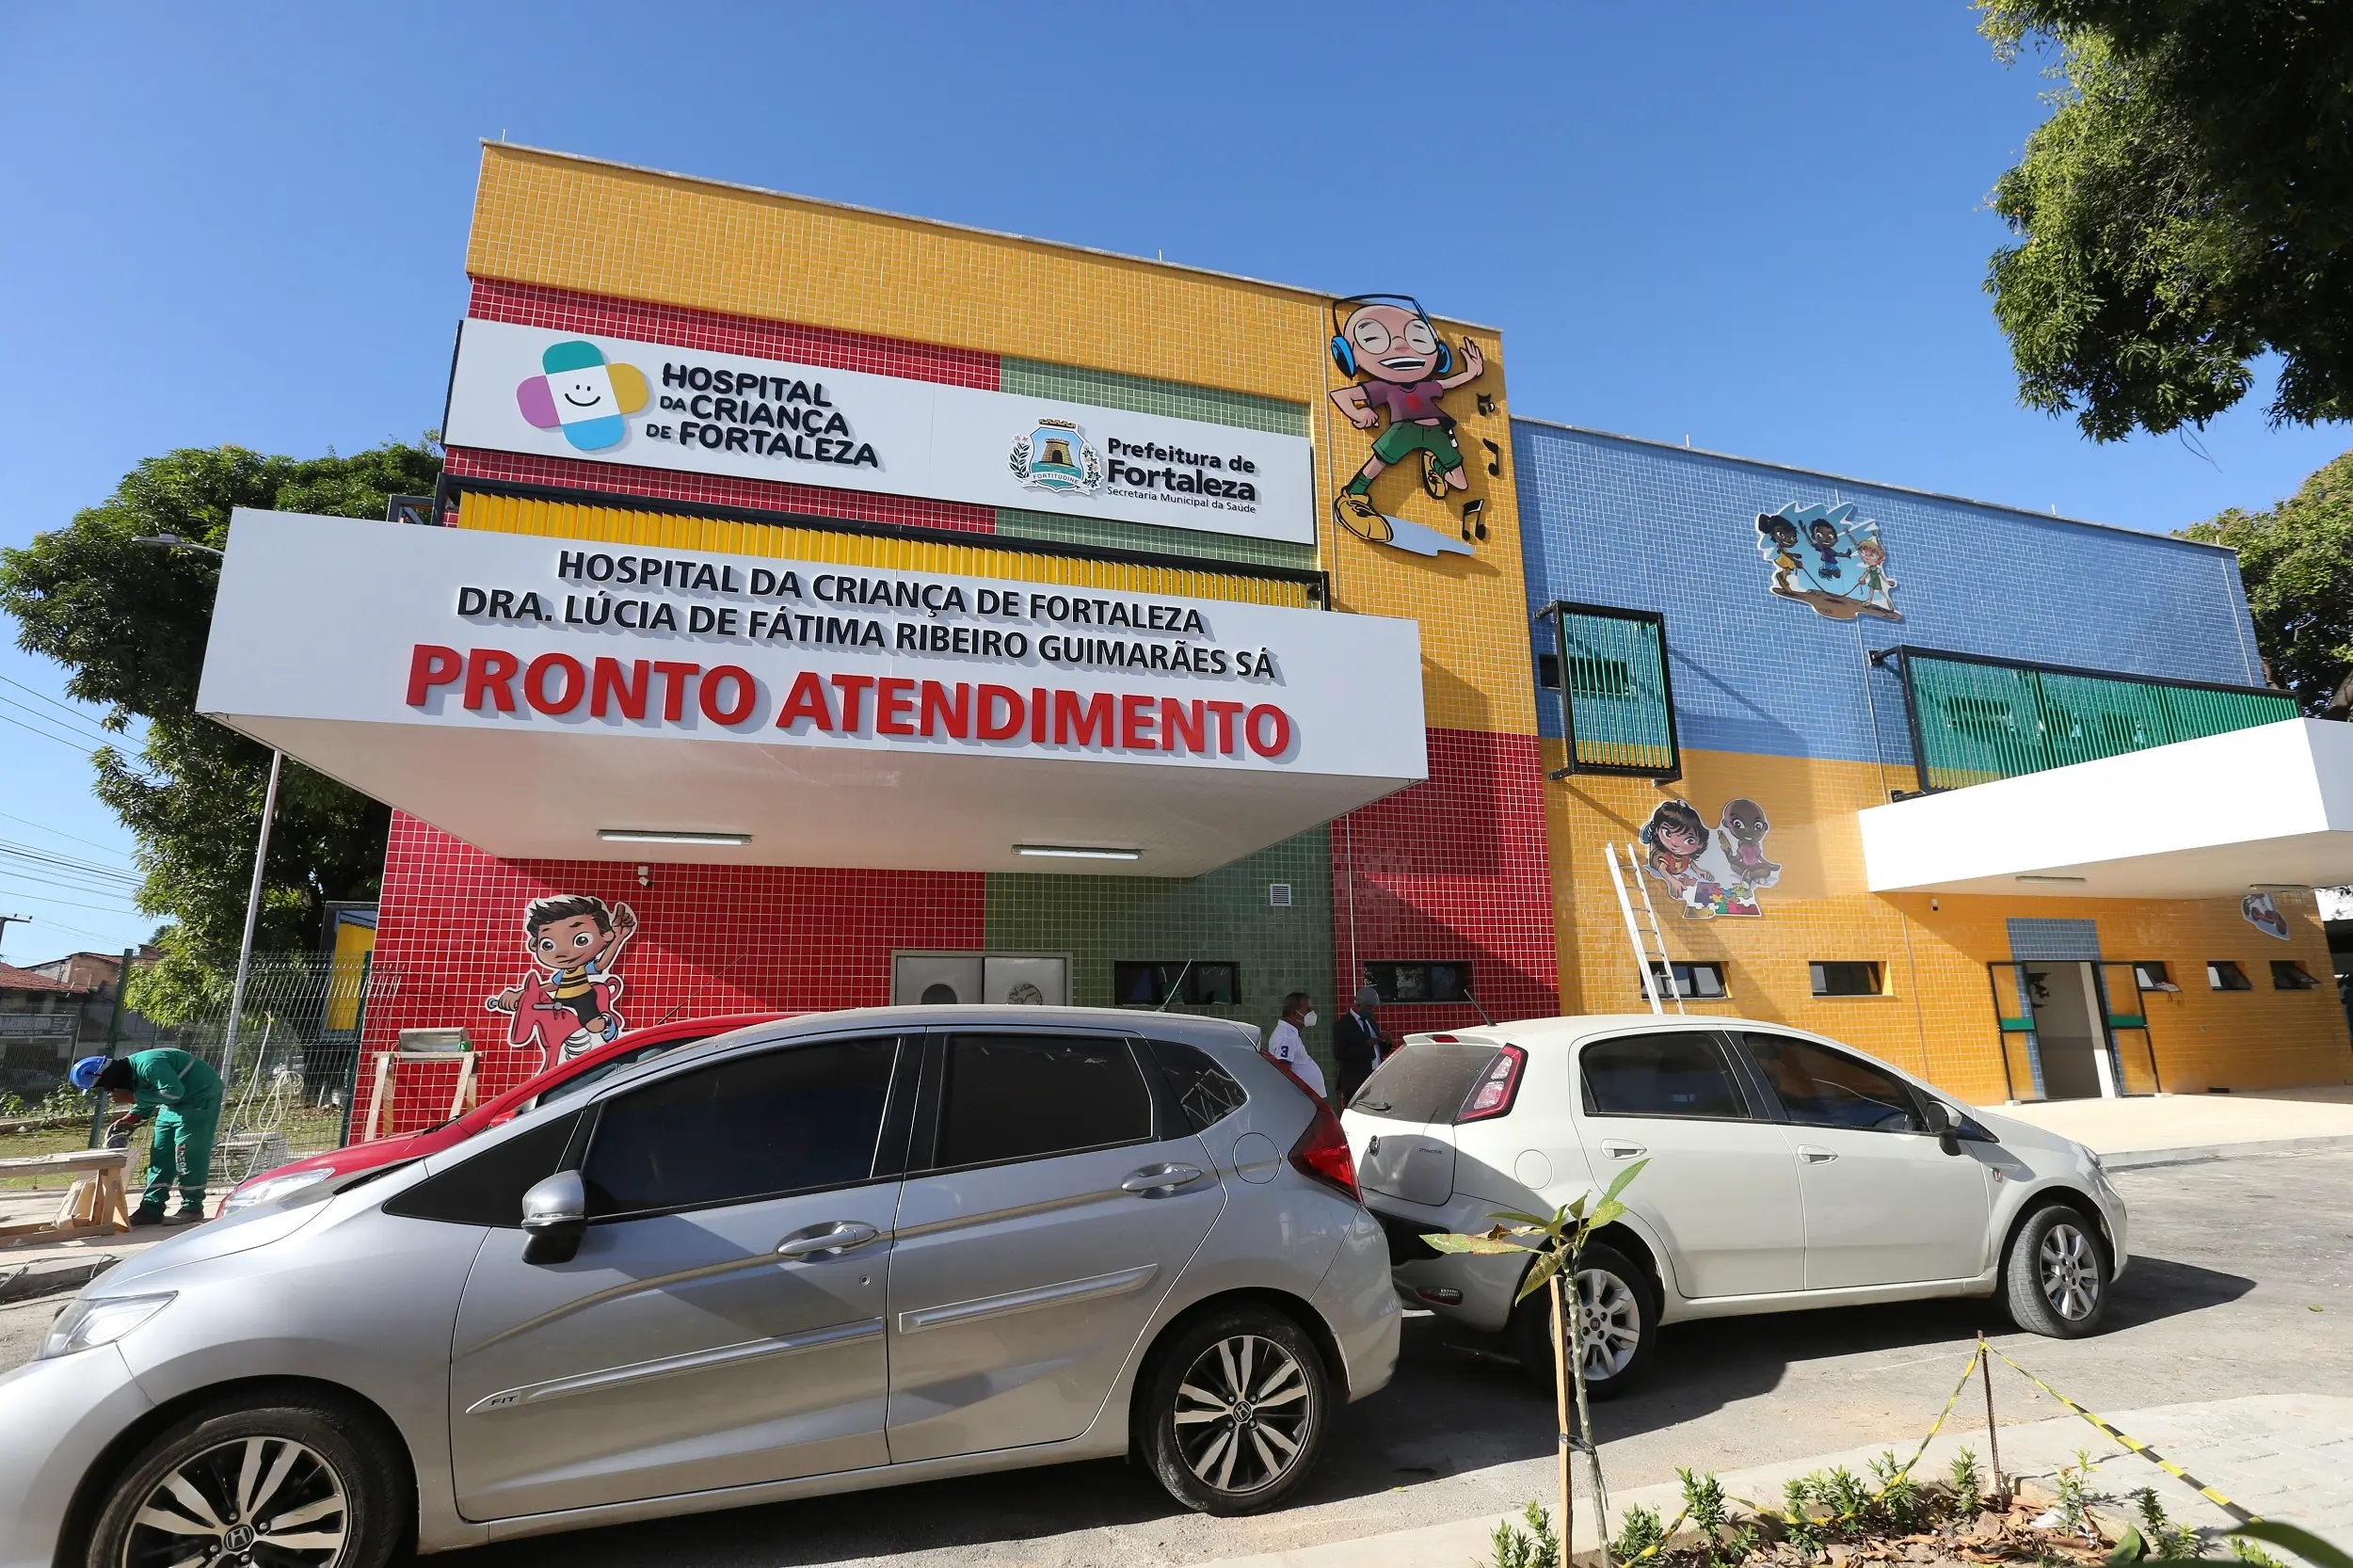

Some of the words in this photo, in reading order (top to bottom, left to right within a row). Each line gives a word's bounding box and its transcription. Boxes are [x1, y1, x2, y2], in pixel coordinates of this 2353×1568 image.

[663, 362, 833, 408] HOSPITAL
[659, 394, 687, 412] DA
[690, 393, 848, 438] CRIANÇA
[646, 423, 672, 440] DE
[679, 420, 878, 469] FORTALEZA
[1107, 437, 1222, 470] Prefeitura
[1228, 455, 1256, 473] de
[1032, 472, 1079, 485] FORTITUDINE
[1106, 486, 1158, 501] Secretaria
[1160, 492, 1209, 508] Municipal
[1211, 497, 1225, 509] da
[1226, 498, 1257, 514] Saúde
[1107, 458, 1256, 502] Fortaleza
[557, 550, 740, 594] HOSPITAL
[749, 568, 803, 599] DA
[812, 573, 967, 618] CRIANÇA
[977, 588, 1019, 617] DE
[1029, 594, 1206, 634] FORTALEZA
[456, 585, 553, 623] DRA.
[564, 590, 678, 632] LÚCIA
[688, 604, 737, 636] DE
[748, 606, 886, 648] FÁTIMA
[895, 621, 1028, 660] RIBEIRO
[1037, 634, 1225, 676] GUIMARÃES
[1236, 647, 1276, 679] SÁ
[406, 644, 756, 726] PRONTO
[775, 671, 1291, 758] ATENDIMENTO
[1280, 1045, 1289, 1058] 3
[490, 1395, 518, 1406] FIT
